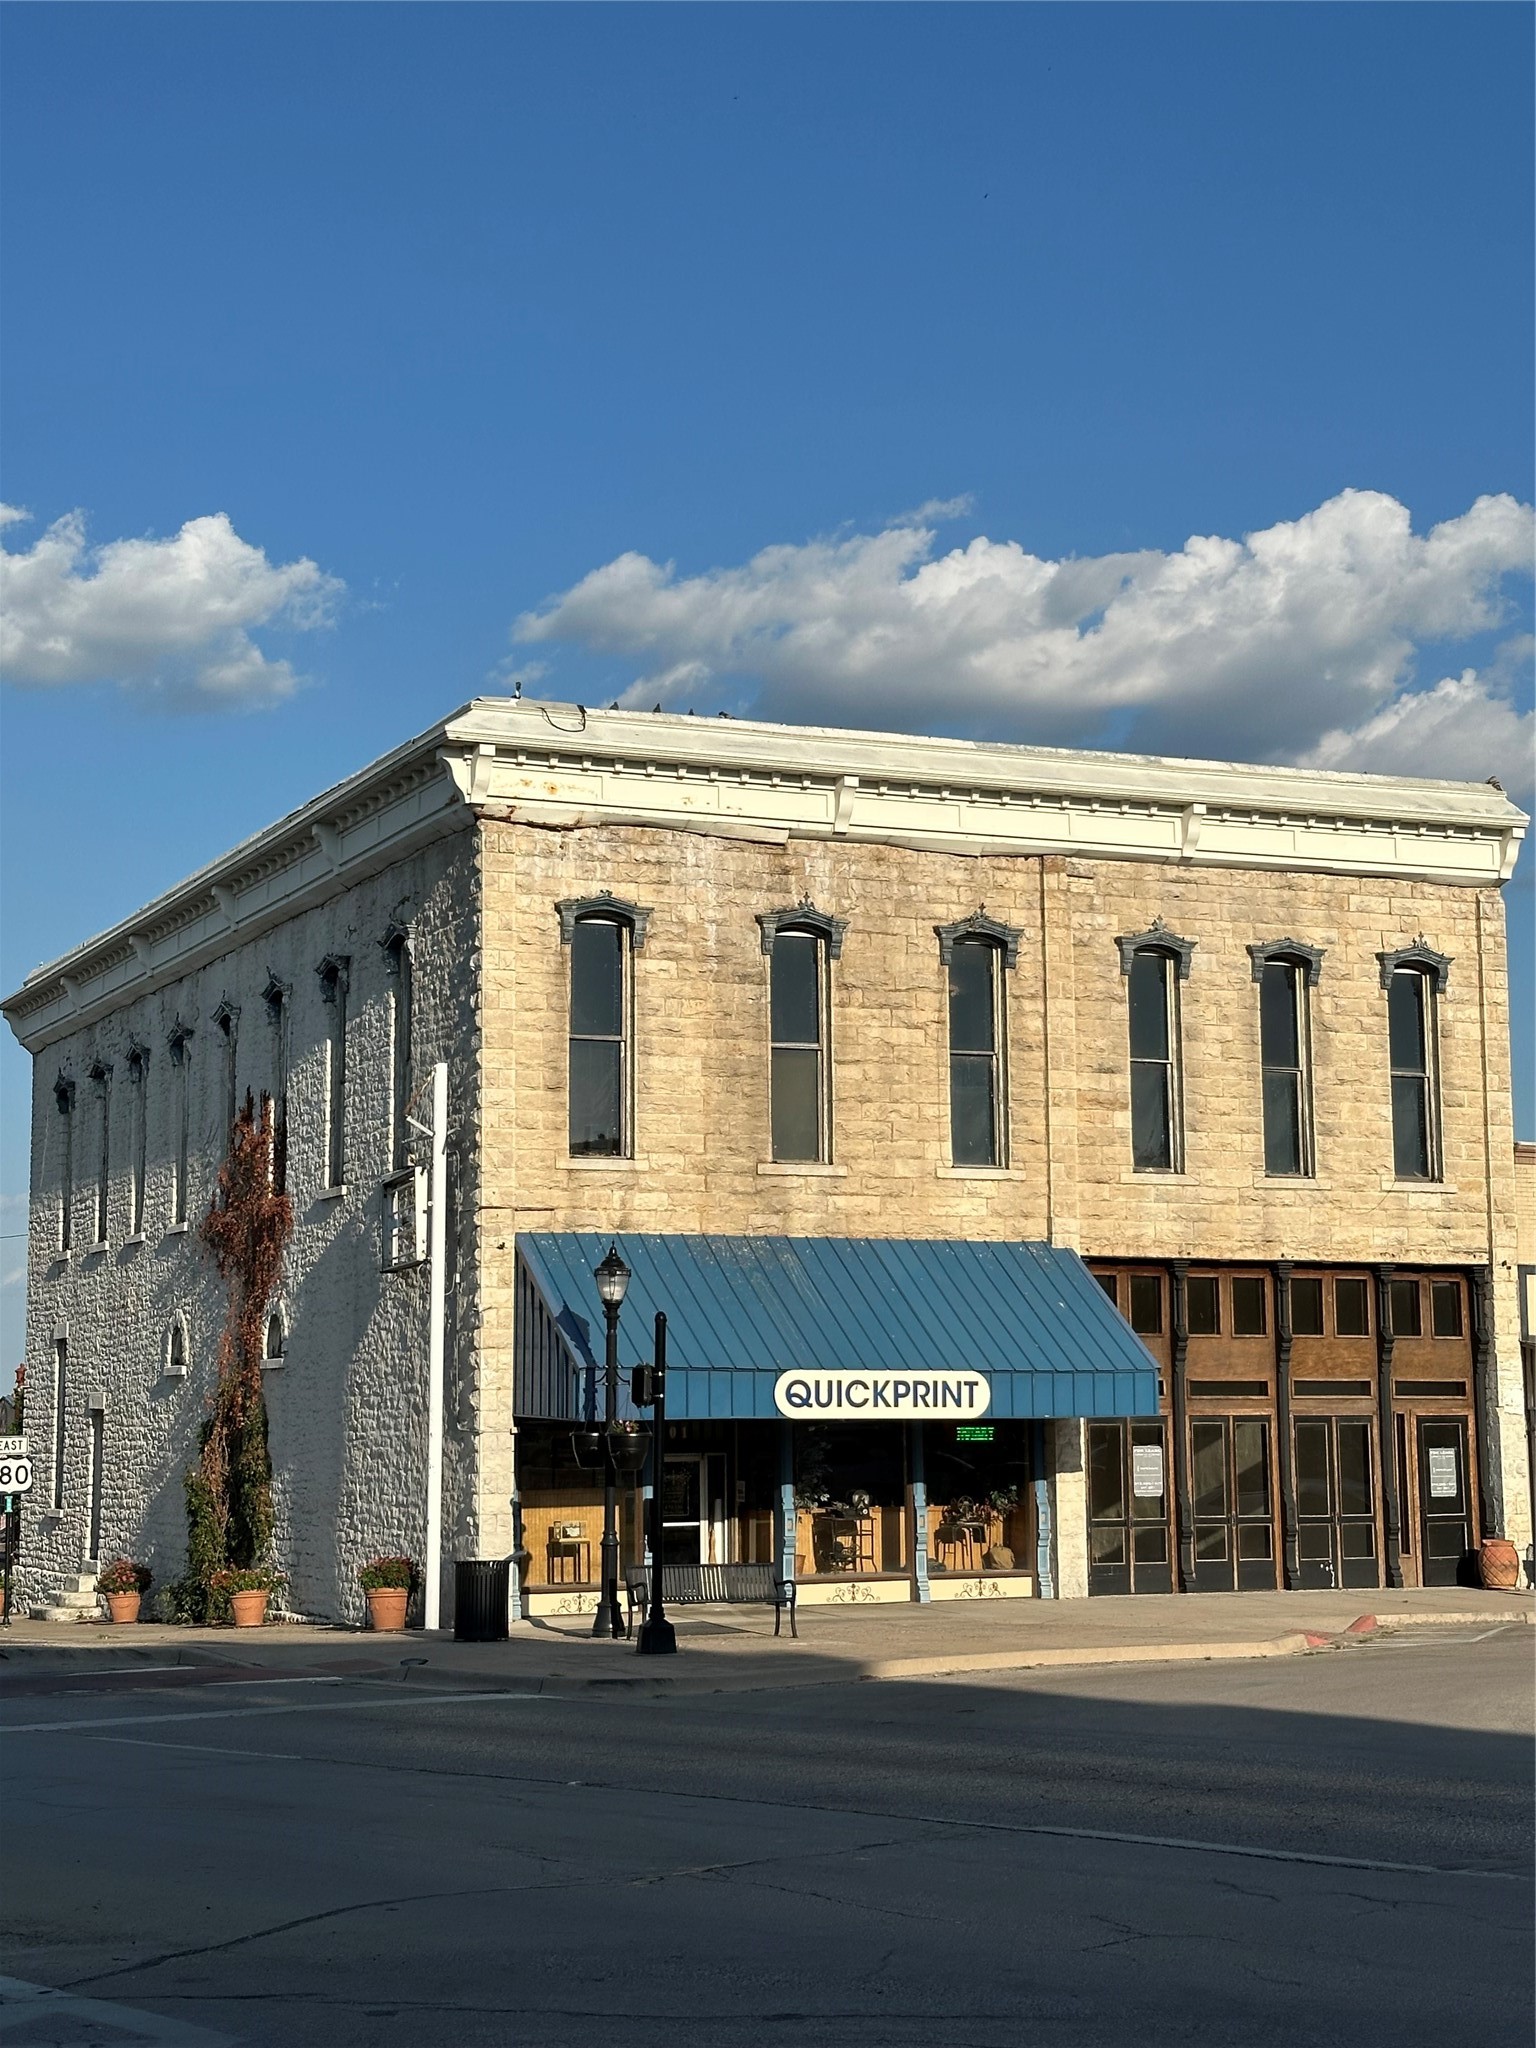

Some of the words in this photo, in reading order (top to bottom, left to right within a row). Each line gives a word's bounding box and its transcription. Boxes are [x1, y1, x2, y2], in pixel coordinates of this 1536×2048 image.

[785, 1379, 979, 1408] QUICKPRINT
[668, 1425, 688, 1440] 01
[0, 1465, 28, 1485] 80
